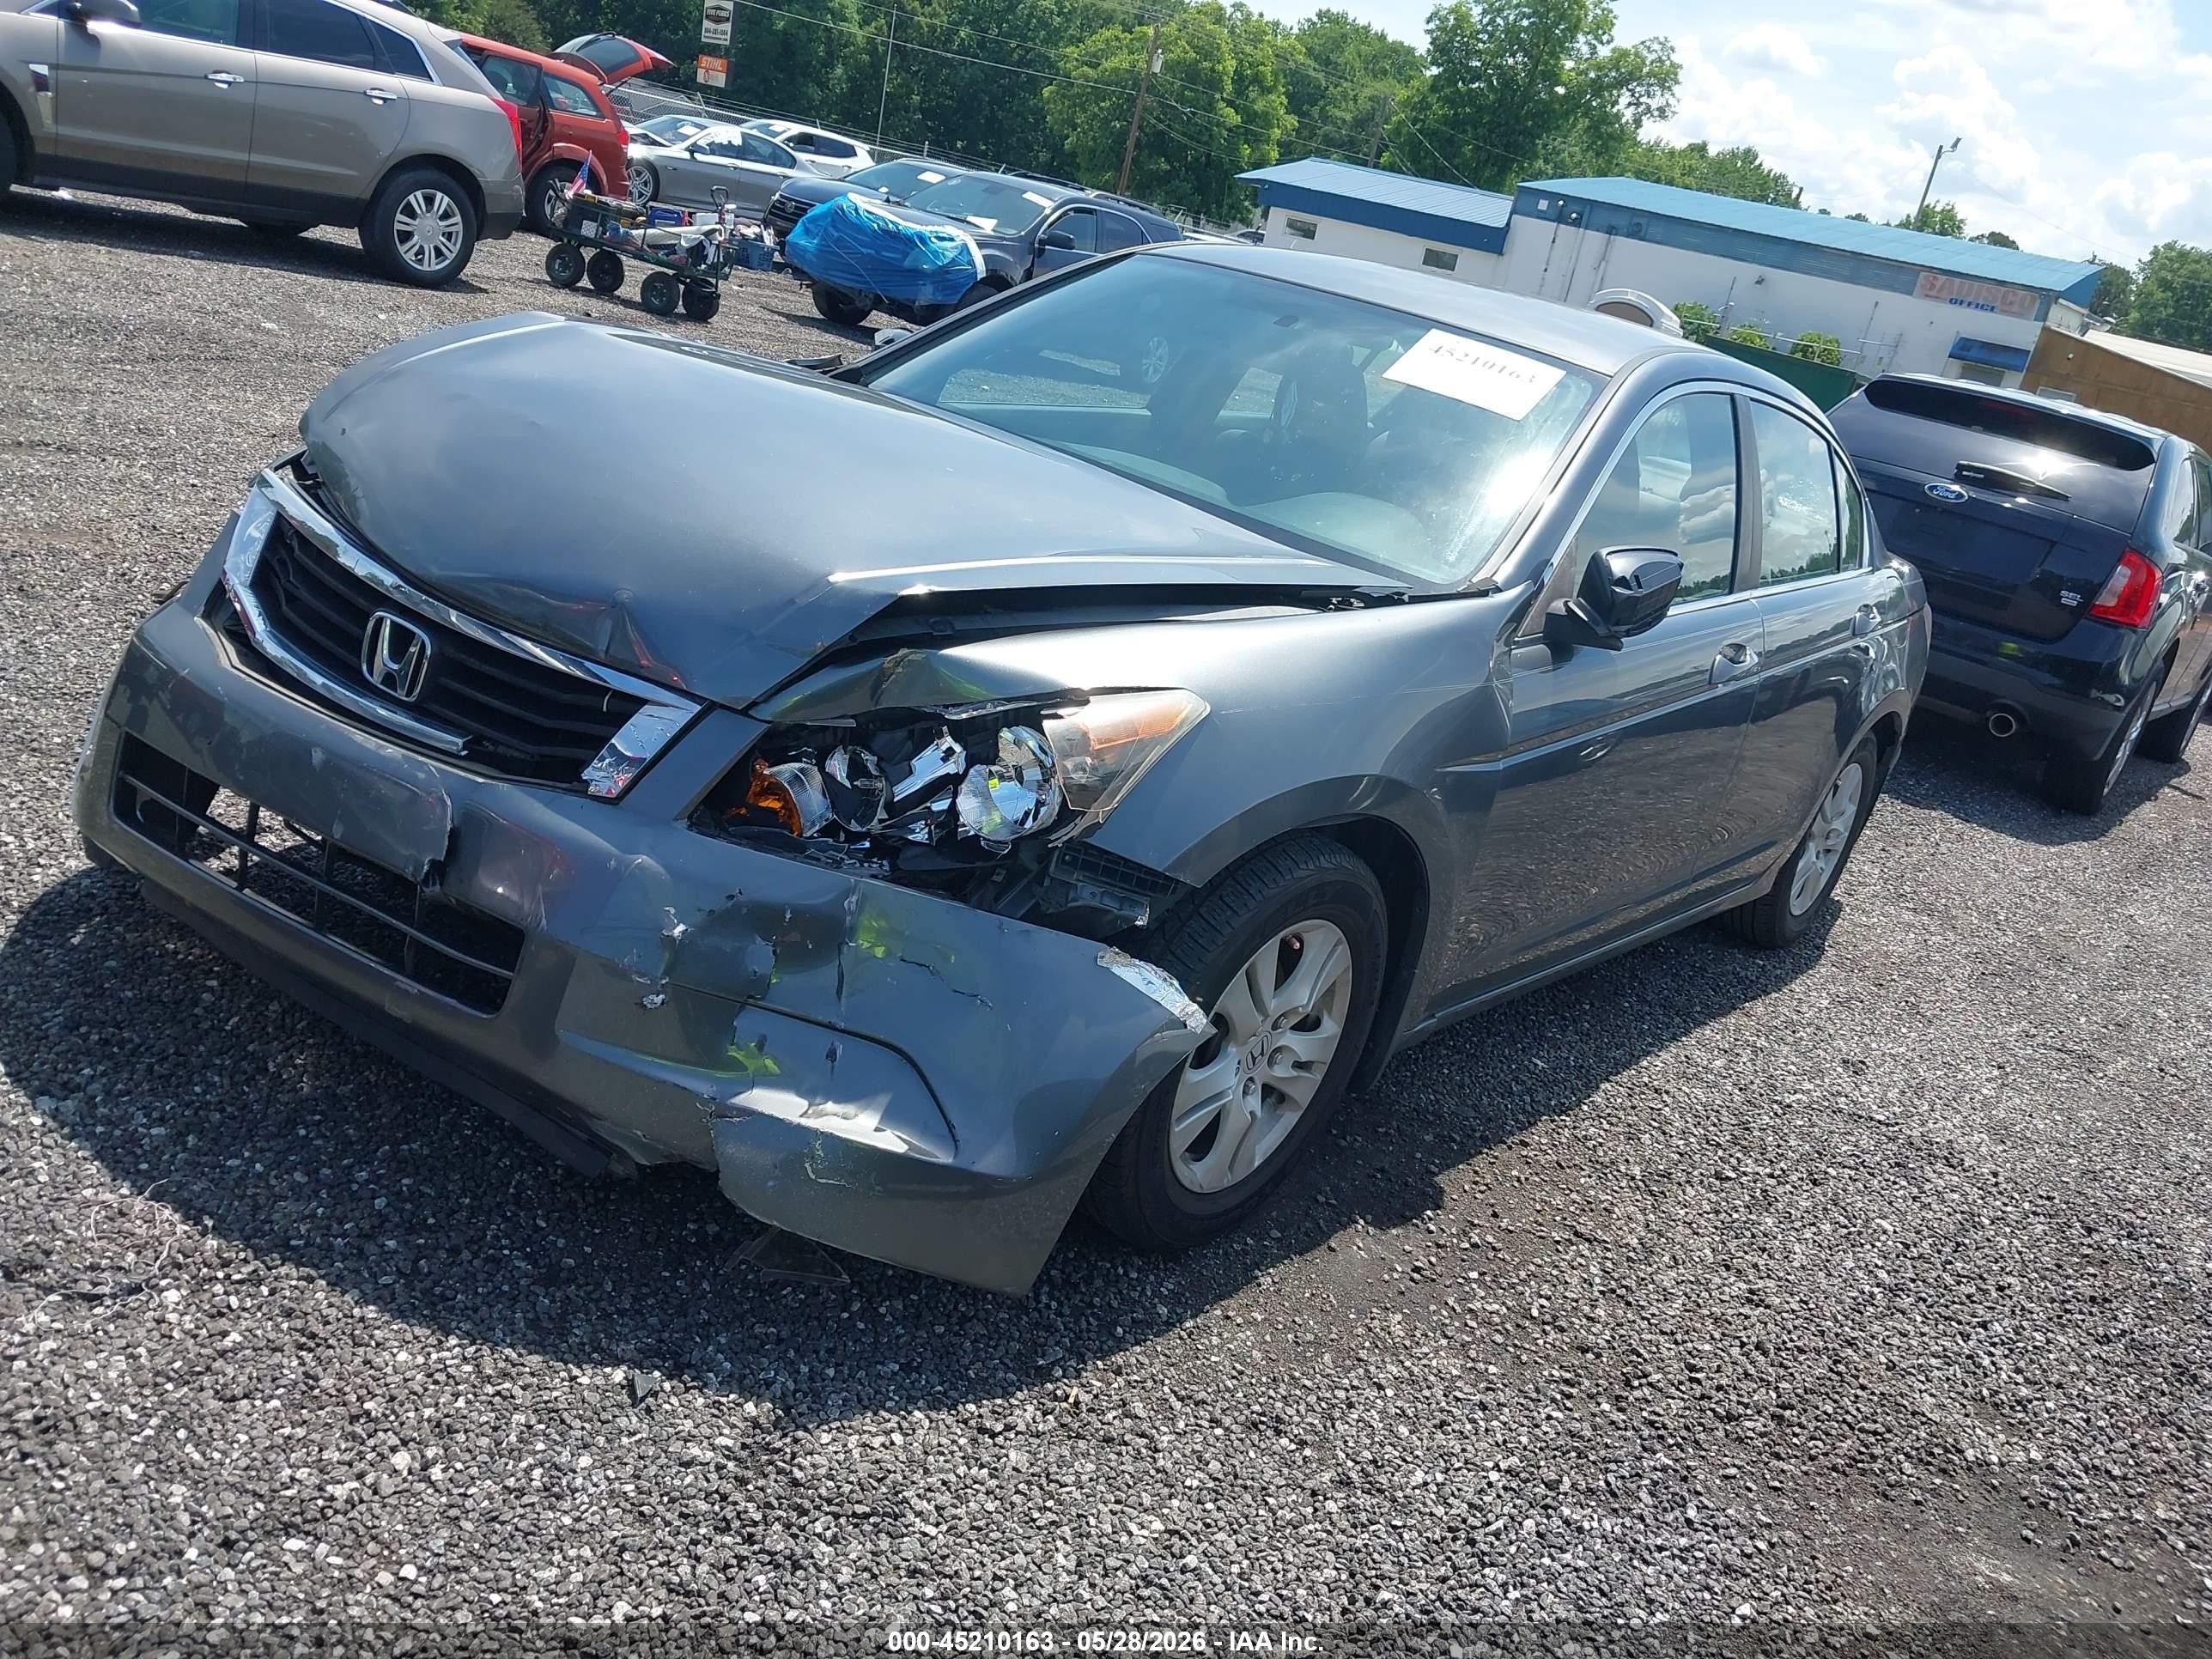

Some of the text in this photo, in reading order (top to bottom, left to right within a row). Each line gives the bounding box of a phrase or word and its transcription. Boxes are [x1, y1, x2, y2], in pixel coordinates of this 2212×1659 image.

[700, 56, 723, 70] STIHL
[1920, 274, 2039, 309] SADISCO
[1948, 297, 1998, 313] OFFICE
[1429, 344, 1536, 384] 45210163
[1932, 485, 1960, 499] Ford
[2059, 590, 2084, 602] SEL
